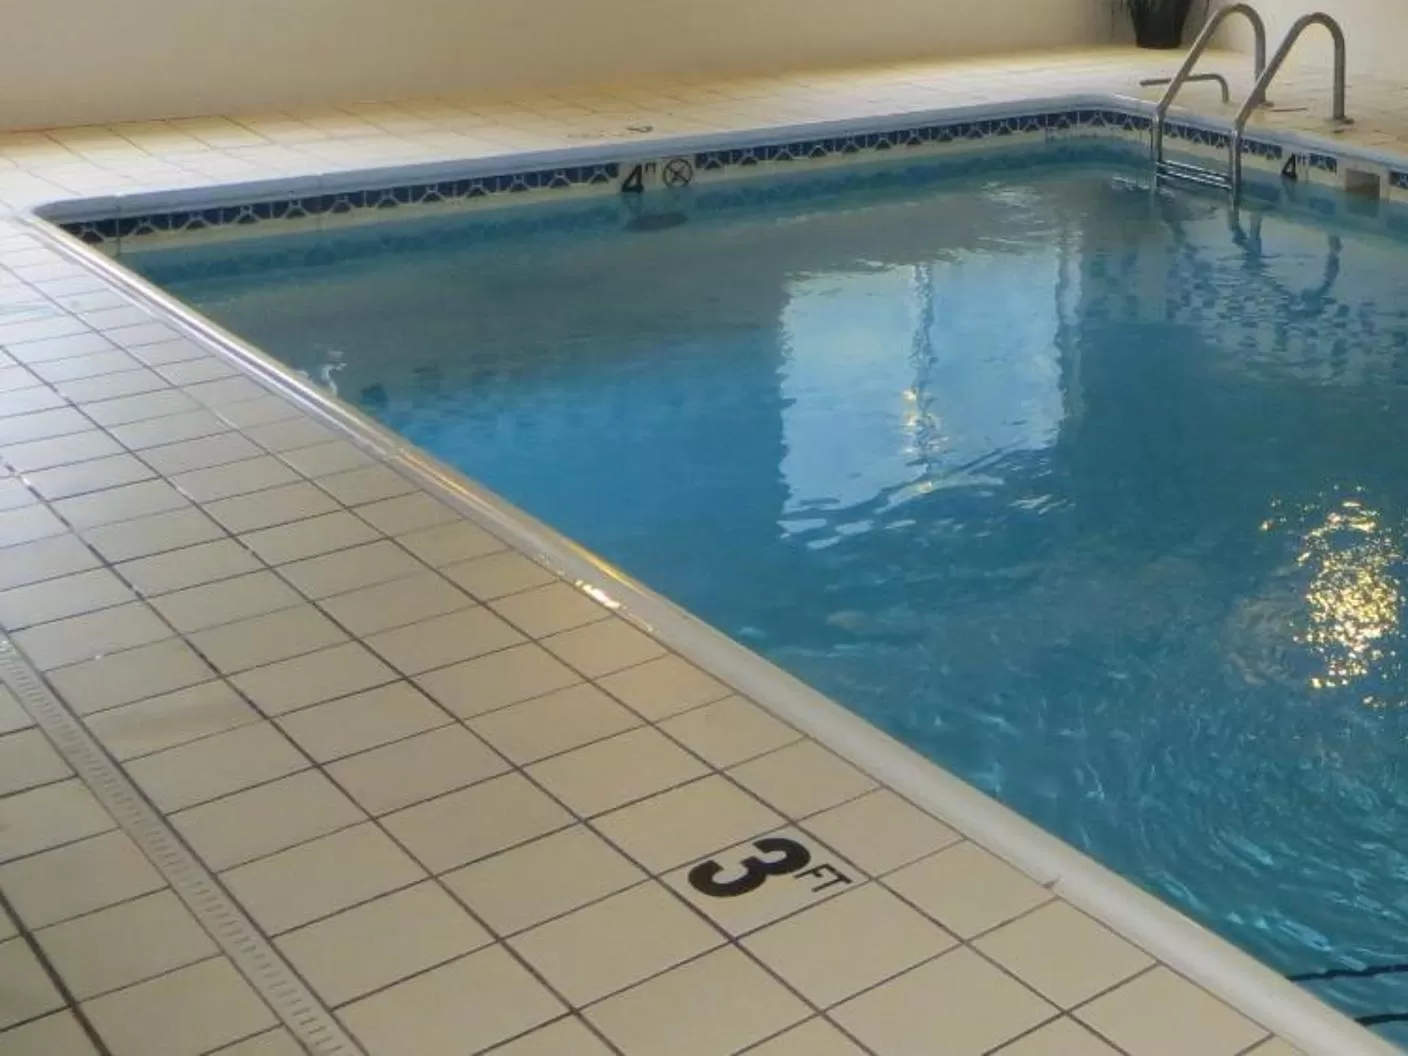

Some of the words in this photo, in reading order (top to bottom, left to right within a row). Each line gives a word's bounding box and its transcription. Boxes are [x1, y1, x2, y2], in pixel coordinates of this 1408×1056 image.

[621, 164, 644, 193] 4
[1281, 152, 1298, 179] 4
[688, 837, 811, 898] 3
[792, 863, 852, 893] FT
